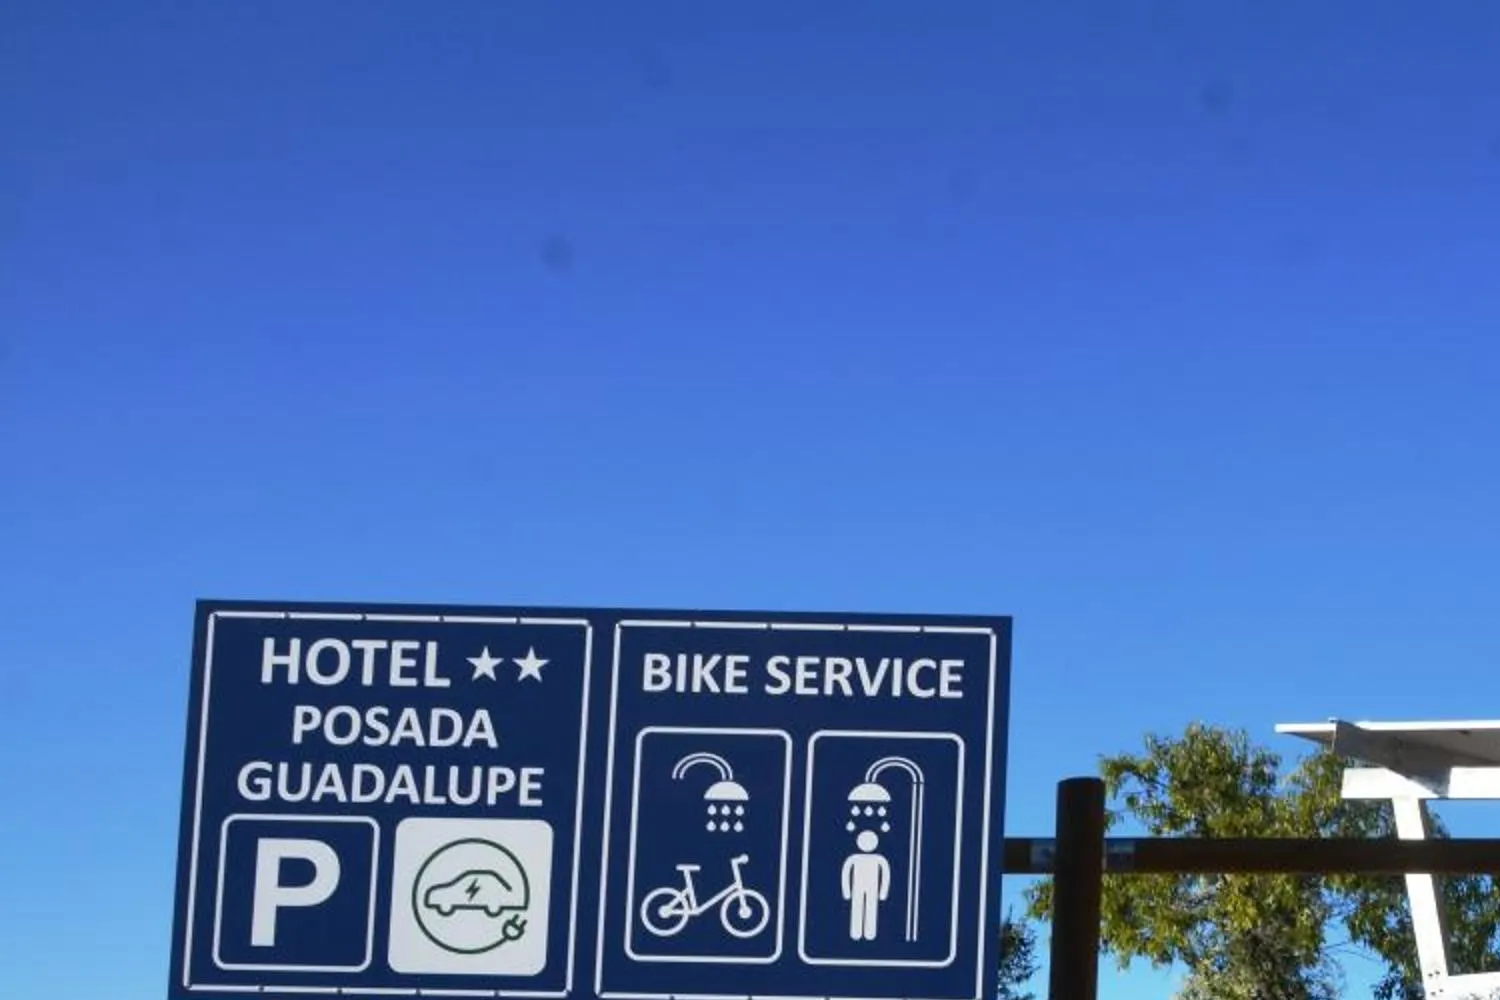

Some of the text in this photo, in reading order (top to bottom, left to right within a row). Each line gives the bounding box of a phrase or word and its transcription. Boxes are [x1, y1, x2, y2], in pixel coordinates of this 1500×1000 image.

[260, 636, 452, 688] HOTEL
[641, 652, 966, 699] BIKE SERVICE
[291, 704, 499, 750] POSADA
[236, 760, 546, 807] GUADALUPE
[250, 836, 342, 948] P
